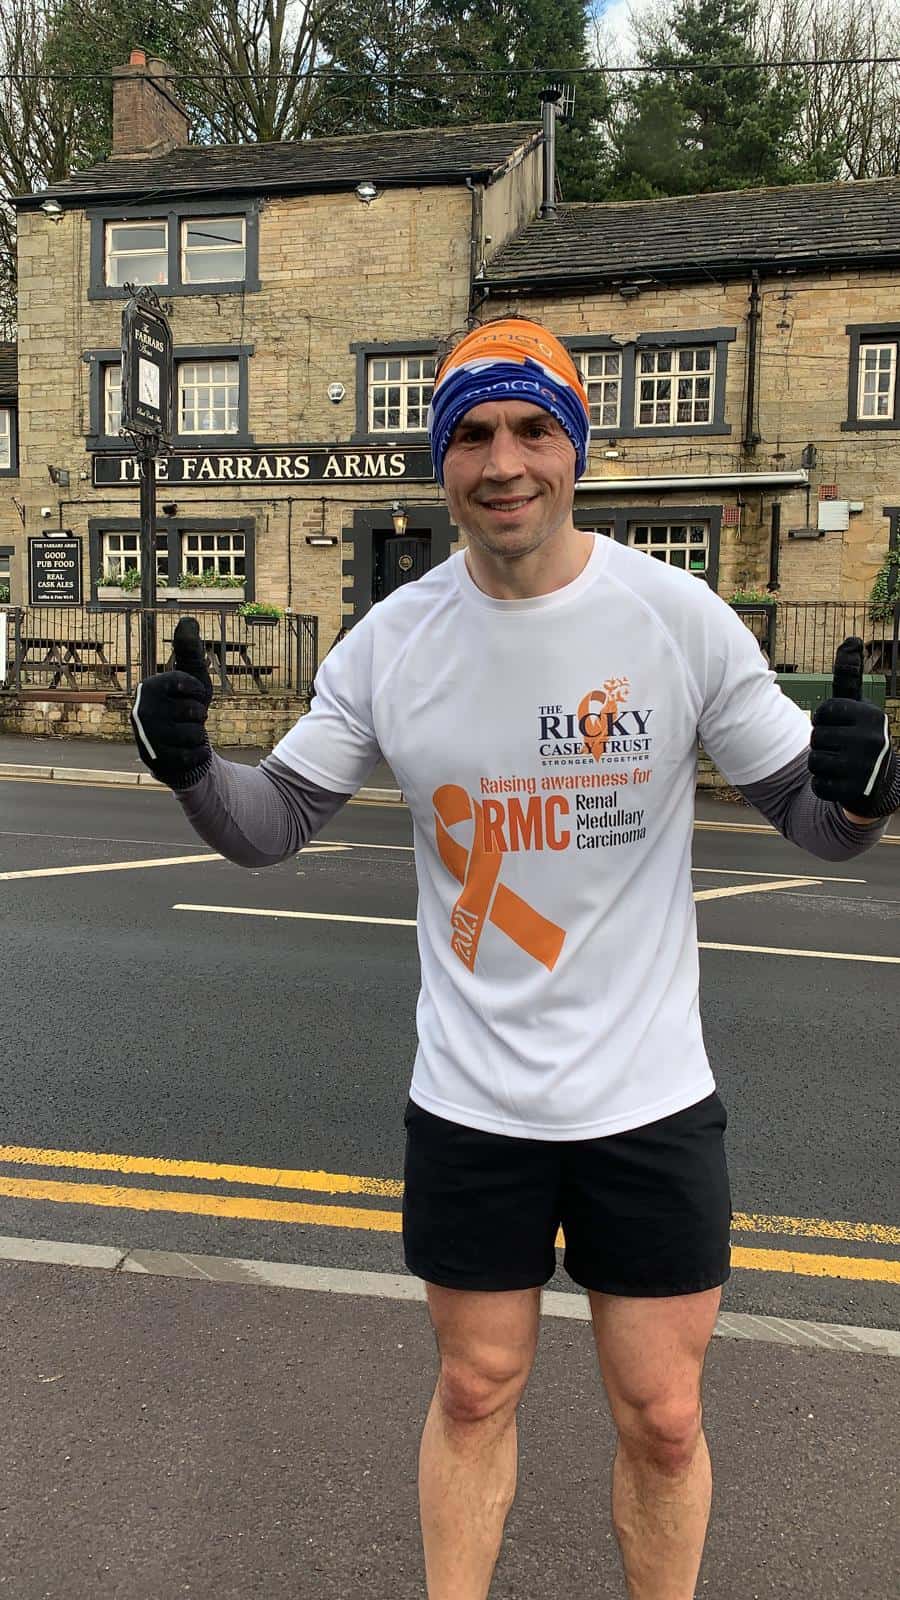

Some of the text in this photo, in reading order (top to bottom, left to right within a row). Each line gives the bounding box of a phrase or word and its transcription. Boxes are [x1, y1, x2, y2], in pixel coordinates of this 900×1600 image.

[135, 328, 164, 353] FARRARS
[182, 456, 310, 480] FARRARS
[322, 453, 406, 478] ARMS
[36, 560, 75, 568] PUB FOOD
[44, 551, 66, 560] GOOD
[46, 573, 65, 581] REAL
[538, 704, 563, 715] THE
[537, 709, 654, 741] RICKY
[539, 738, 653, 757] CASEY TRUST
[541, 754, 650, 767] STRONGER TOGETHER
[480, 767, 652, 795] Raising awareness for
[575, 791, 617, 811] Renal
[482, 794, 571, 852] RMC
[576, 809, 645, 831] Medullary
[576, 826, 647, 850] Carcinoma
